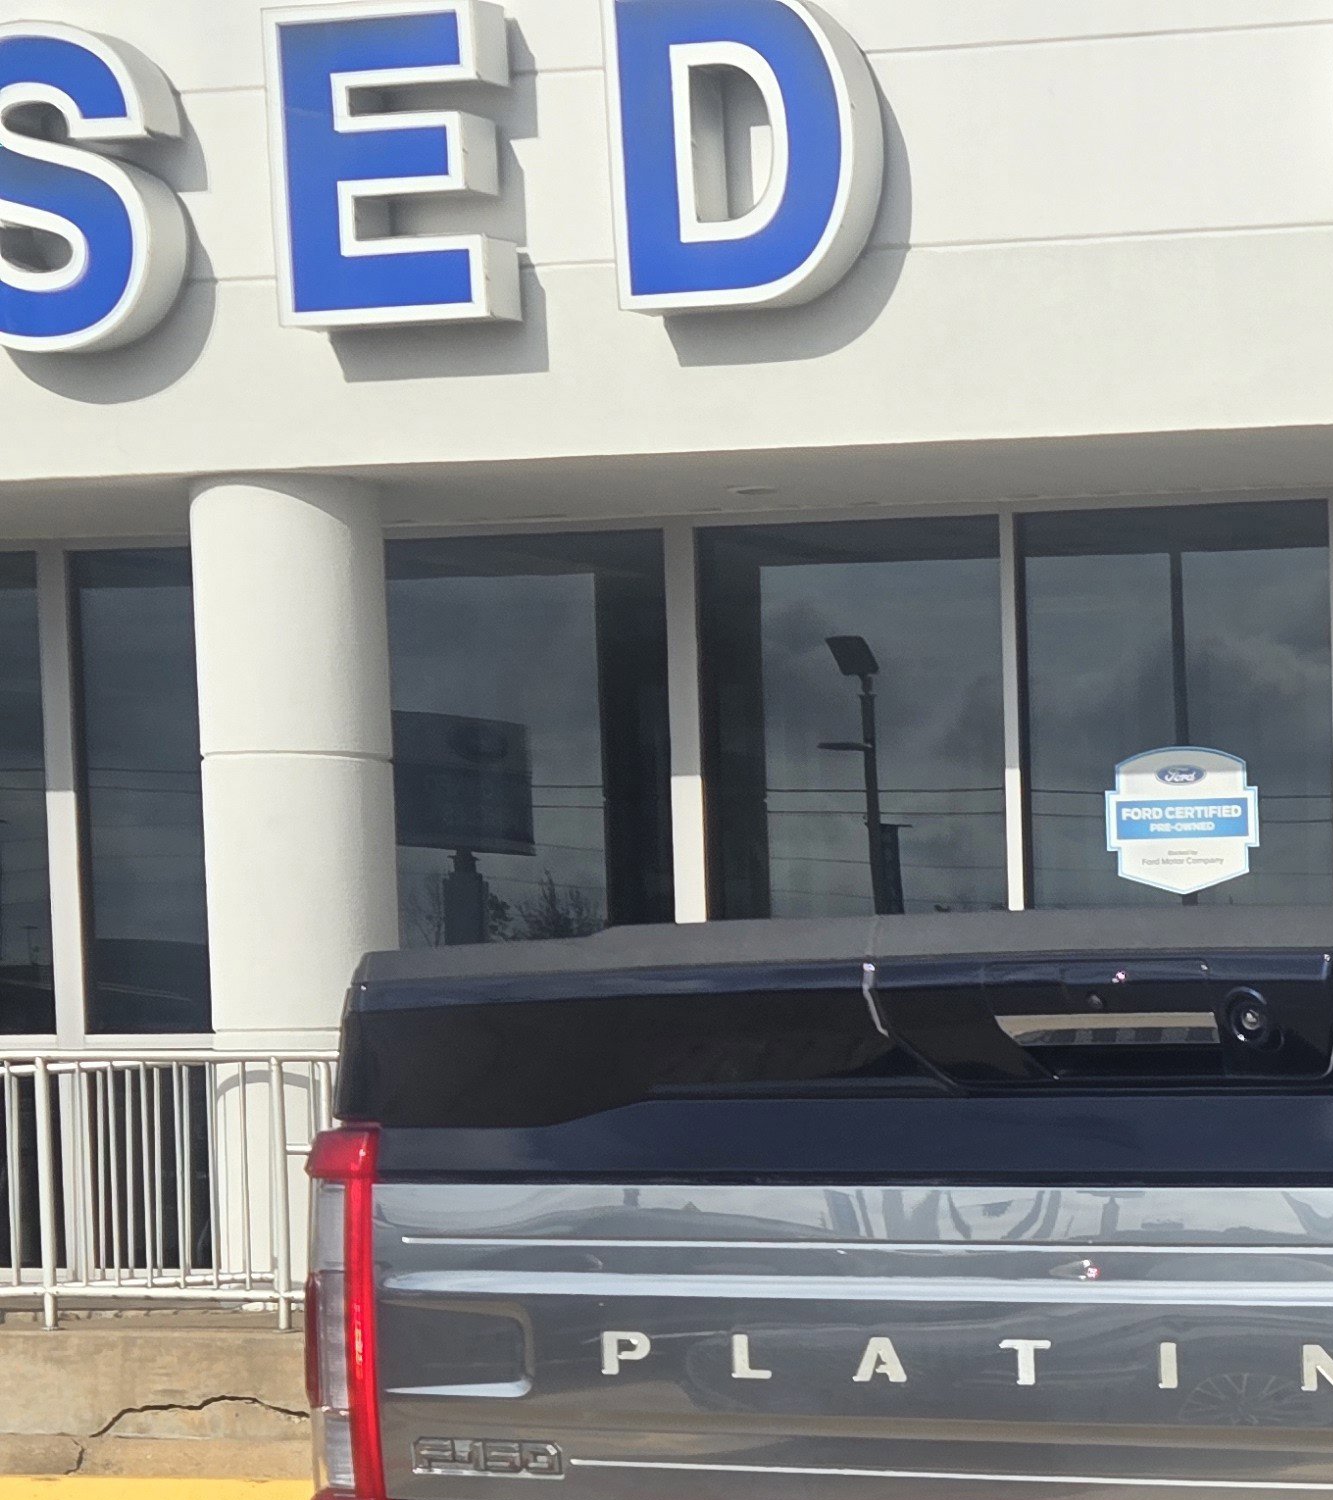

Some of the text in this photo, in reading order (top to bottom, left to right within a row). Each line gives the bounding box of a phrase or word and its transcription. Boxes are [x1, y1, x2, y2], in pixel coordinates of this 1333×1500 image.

[1121, 805, 1242, 821] FORD CERTIFIED
[1150, 822, 1215, 833] PRE-OWNED
